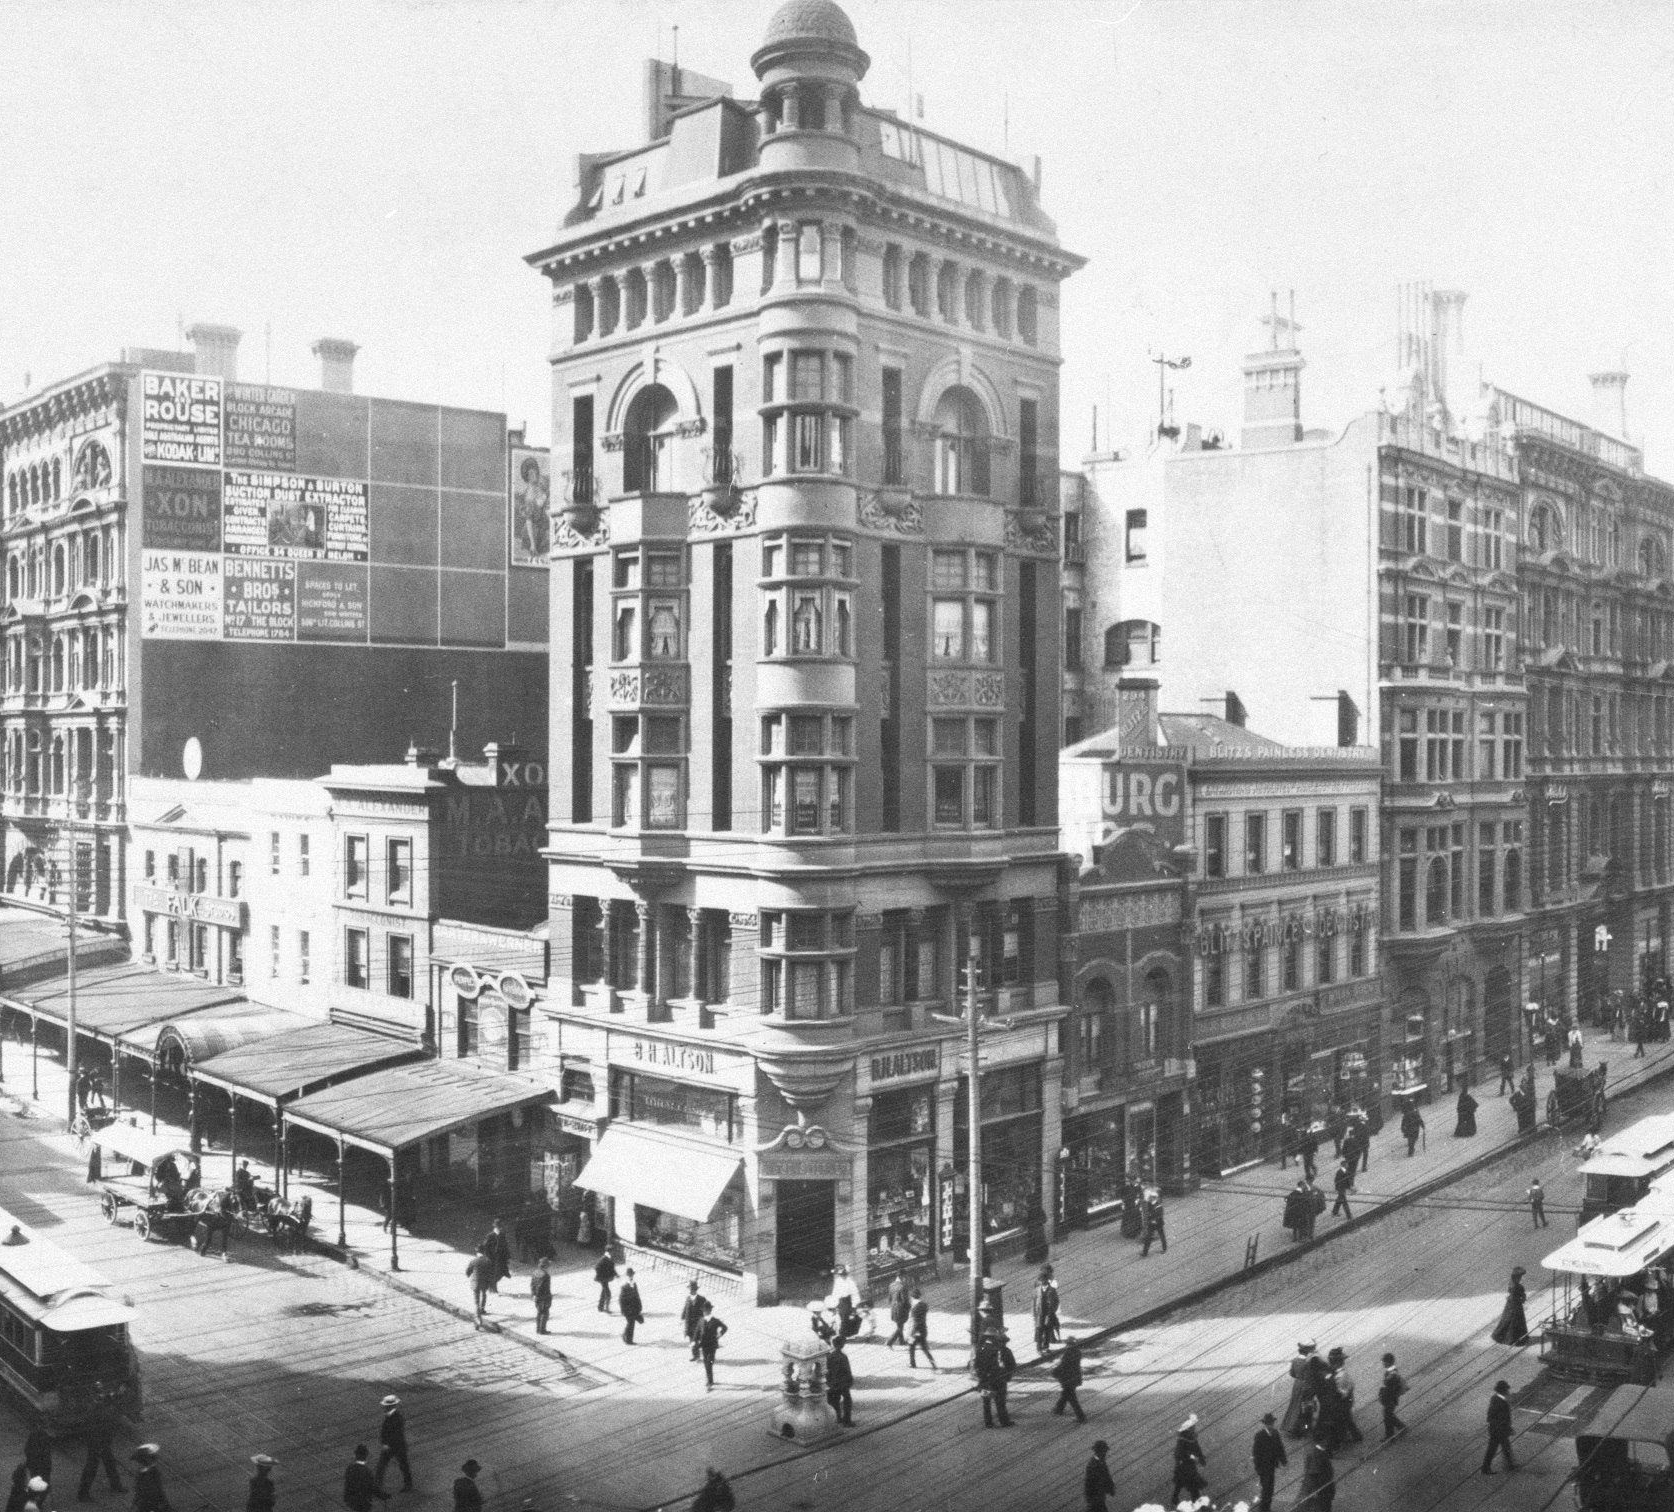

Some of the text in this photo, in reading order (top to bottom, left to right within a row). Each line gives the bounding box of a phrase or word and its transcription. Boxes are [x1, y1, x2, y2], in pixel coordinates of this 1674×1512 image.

[145, 376, 219, 401] BAKER
[145, 399, 219, 425] ROUSE
[226, 400, 293, 418] BLOCK ARCADE
[229, 415, 291, 435] CHICAGO
[227, 431, 295, 450] TEA ROOMS
[157, 442, 194, 461] KODAK
[248, 447, 285, 459] COLLINS
[250, 474, 306, 489] SIMPSON
[316, 480, 364, 495] BURTON
[157, 491, 209, 518] XON
[224, 495, 266, 507] ESTIMATES
[225, 485, 367, 507] SUCTION DUST EXTRACTOR
[224, 514, 267, 527] CONTRACTS
[239, 545, 270, 557] OFFICE
[287, 548, 314, 559] QUEEN
[144, 556, 170, 573] JAS
[188, 557, 219, 575] BEAN
[224, 559, 294, 580] BENNETTS
[160, 578, 203, 595] & SON
[304, 580, 332, 590] SPACES
[333, 581, 344, 591] TO
[144, 599, 219, 612] WATCHMAKERS
[226, 599, 292, 616] TAILORS
[347, 601, 363, 610] SON
[148, 611, 216, 624] & JEWELLERS
[236, 614, 294, 628] 17 THE BLOCK
[161, 625, 196, 635] TELEPHONE
[228, 627, 269, 638] TELEPHONE
[1120, 745, 1187, 761] DENTISTRY
[1257, 745, 1310, 759] PAINLESS
[502, 762, 544, 787] XO
[1101, 771, 1181, 818] URG
[358, 801, 426, 816] ALEXANDER
[489, 933, 544, 955] WERNER
